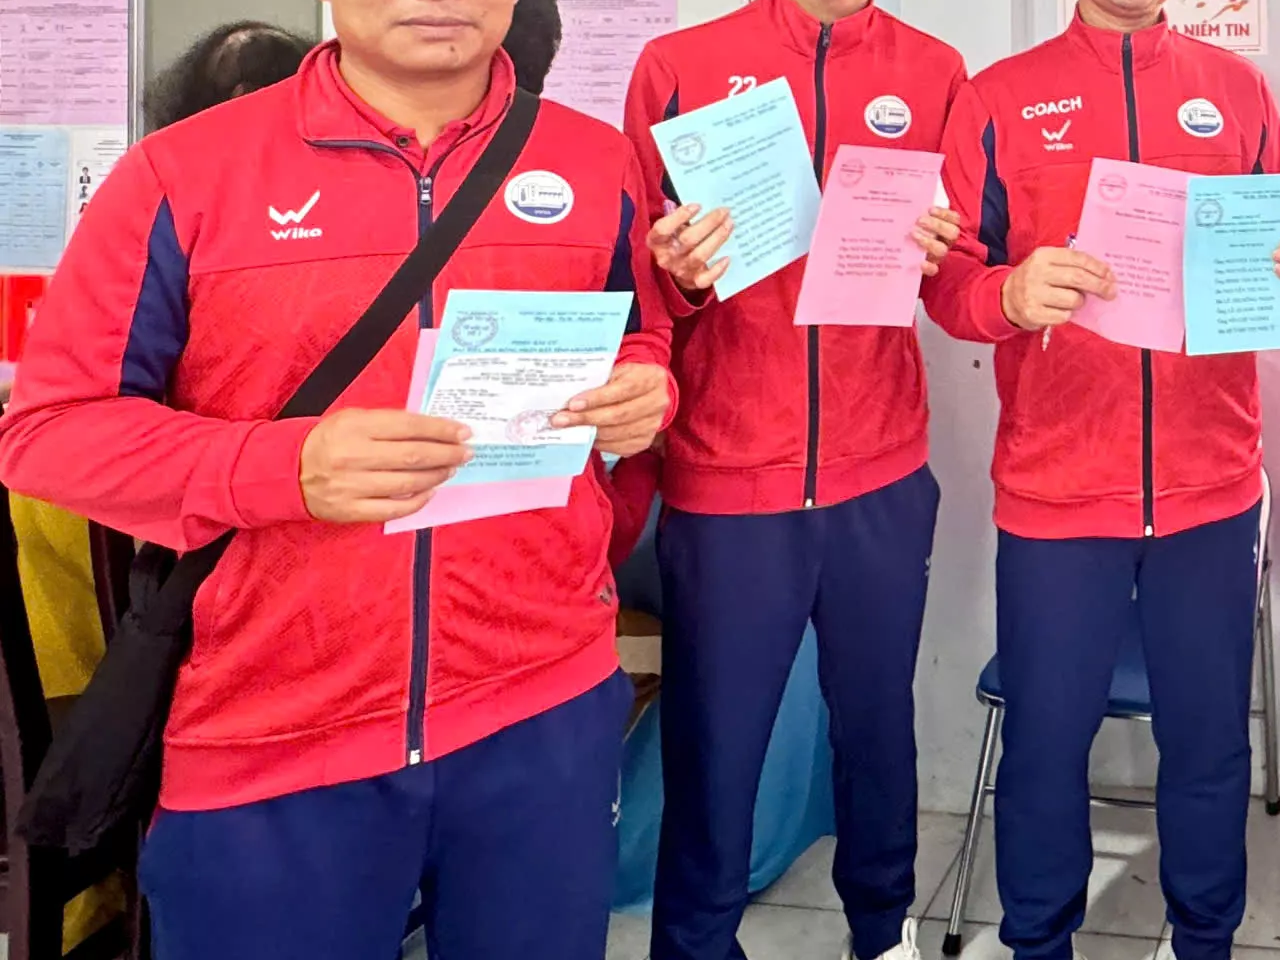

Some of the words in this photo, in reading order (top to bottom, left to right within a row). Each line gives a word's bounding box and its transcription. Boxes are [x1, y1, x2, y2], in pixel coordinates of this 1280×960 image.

[1225, 23, 1250, 36] TIN
[728, 75, 757, 99] 22
[1021, 95, 1082, 119] COACH
